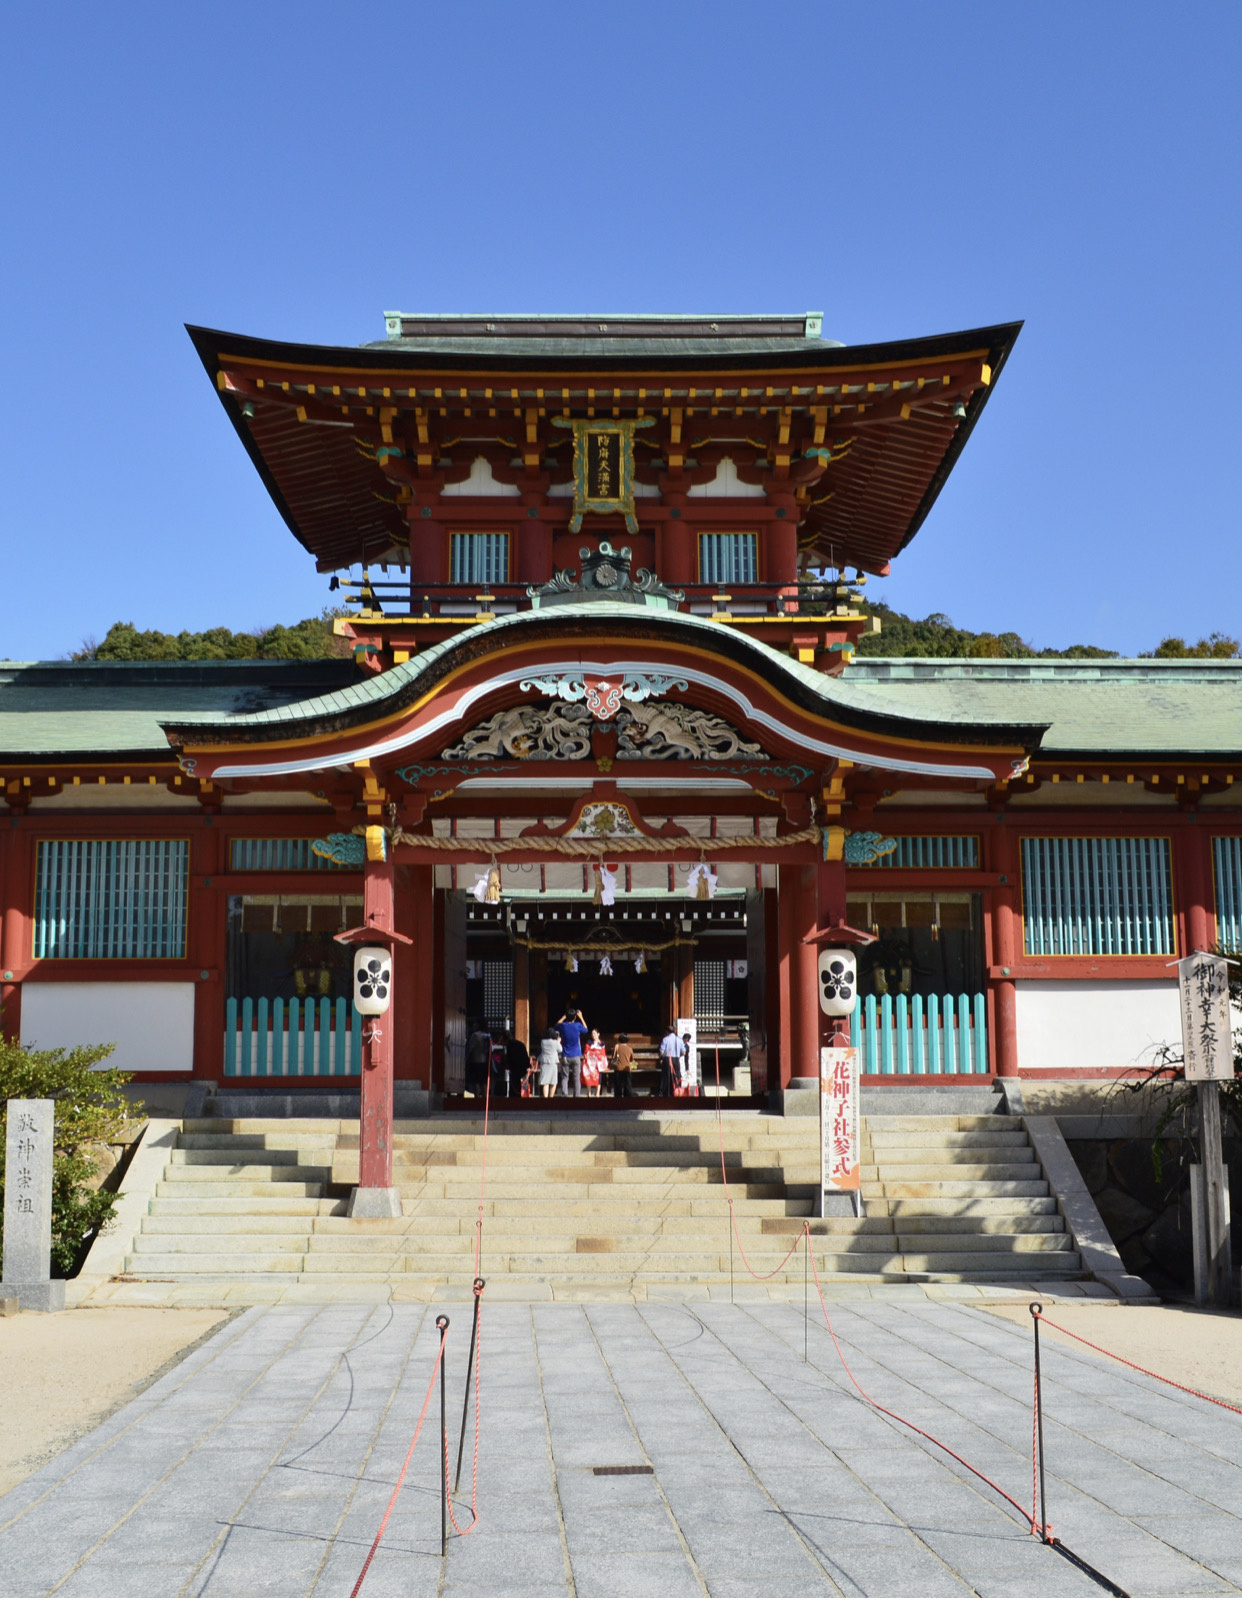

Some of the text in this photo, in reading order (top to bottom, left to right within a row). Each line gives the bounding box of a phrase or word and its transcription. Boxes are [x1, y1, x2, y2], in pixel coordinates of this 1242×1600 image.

[1216, 970, 1227, 1019] 令和元年
[17, 1113, 39, 1213] 敬神崇祖
[832, 1061, 850, 1175] 花神子社参式
